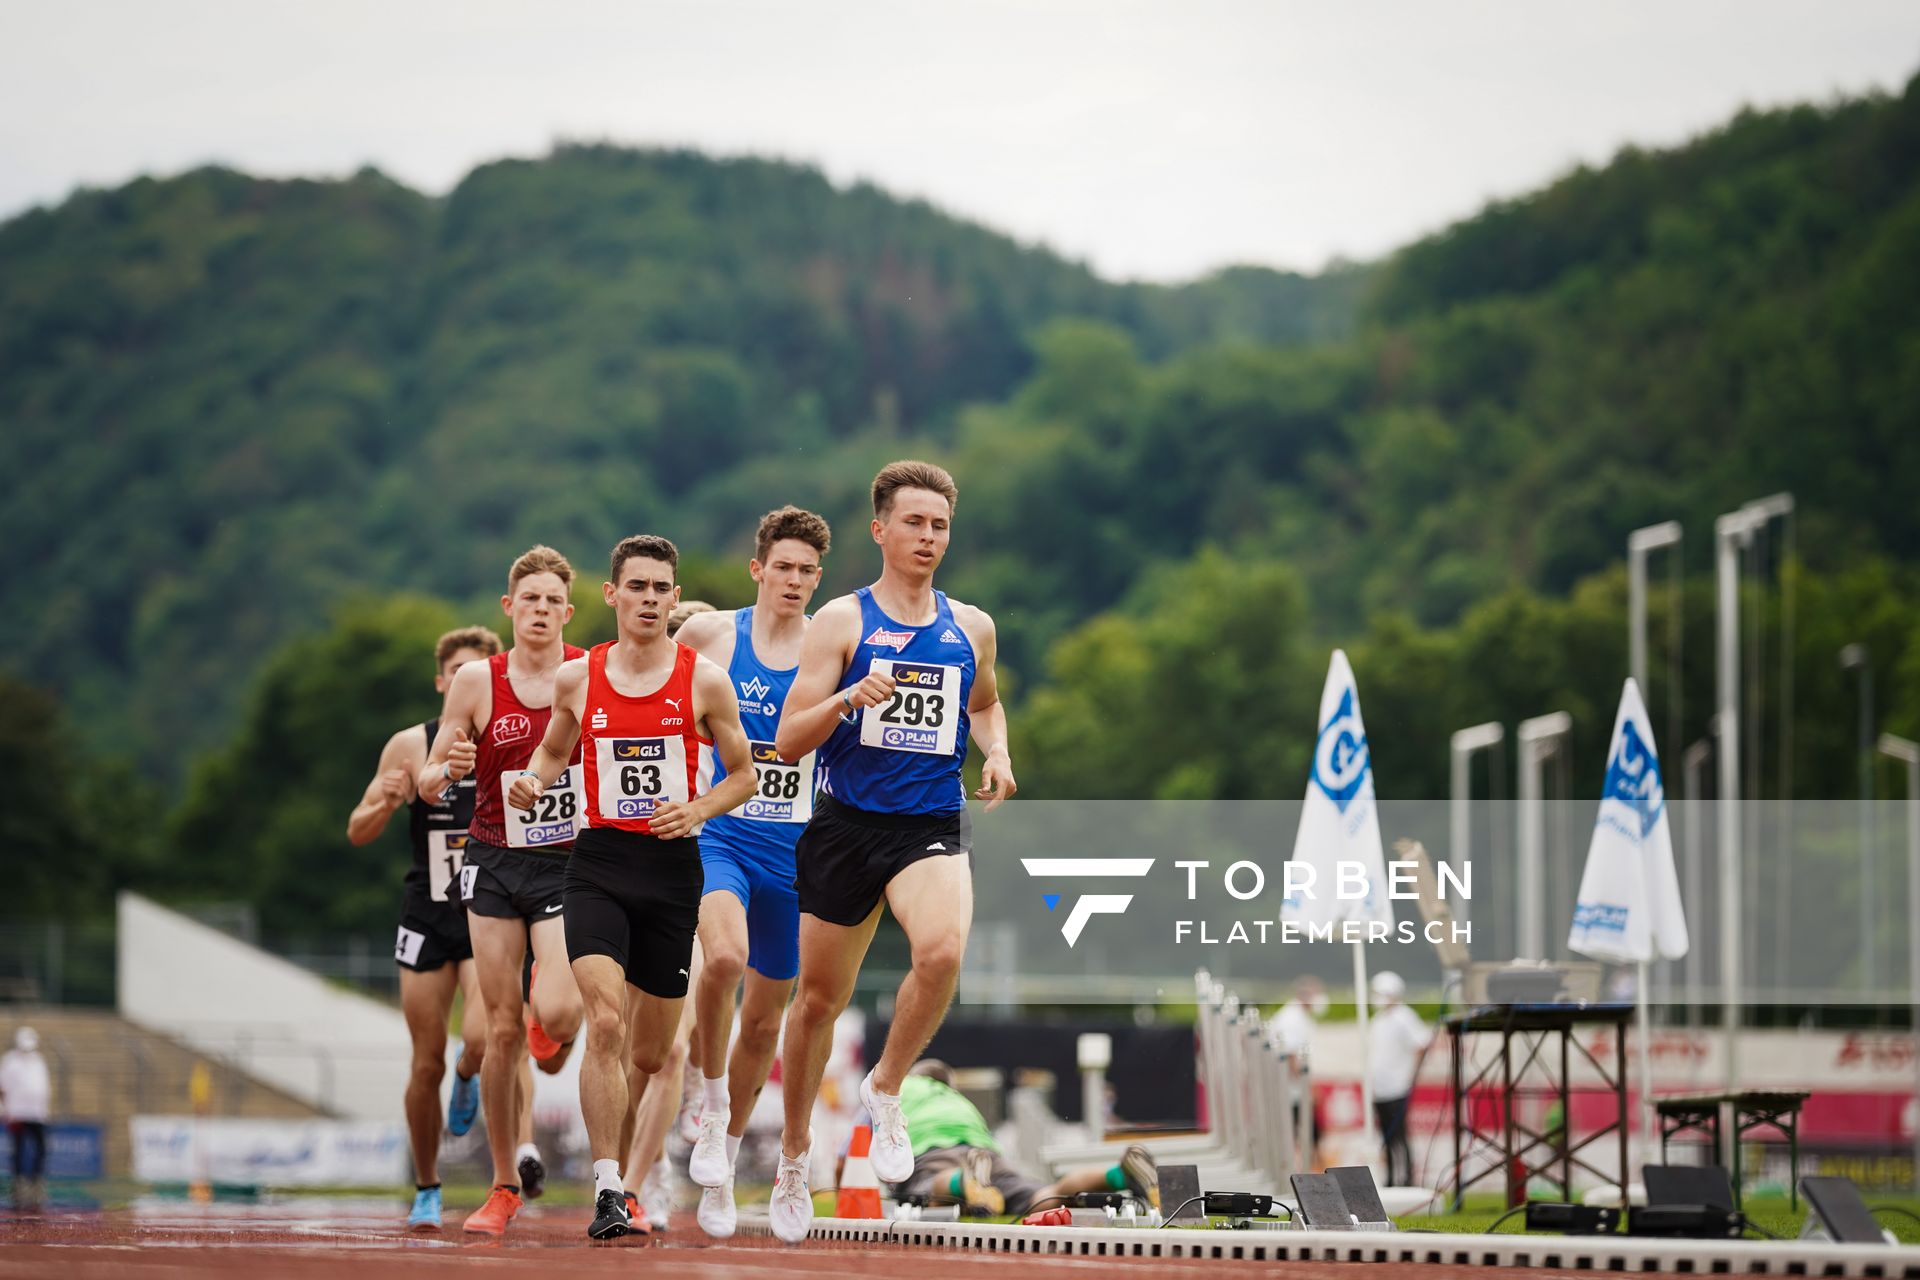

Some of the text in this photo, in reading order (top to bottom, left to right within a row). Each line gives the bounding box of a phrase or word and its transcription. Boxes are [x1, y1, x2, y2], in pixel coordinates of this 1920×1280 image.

[918, 672, 940, 686] GLS
[879, 691, 945, 728] 293
[906, 732, 936, 744] PLAN
[640, 745, 661, 757] GLS
[620, 765, 662, 796] 63
[764, 804, 791, 814] PLAN
[546, 823, 572, 836] PLAN
